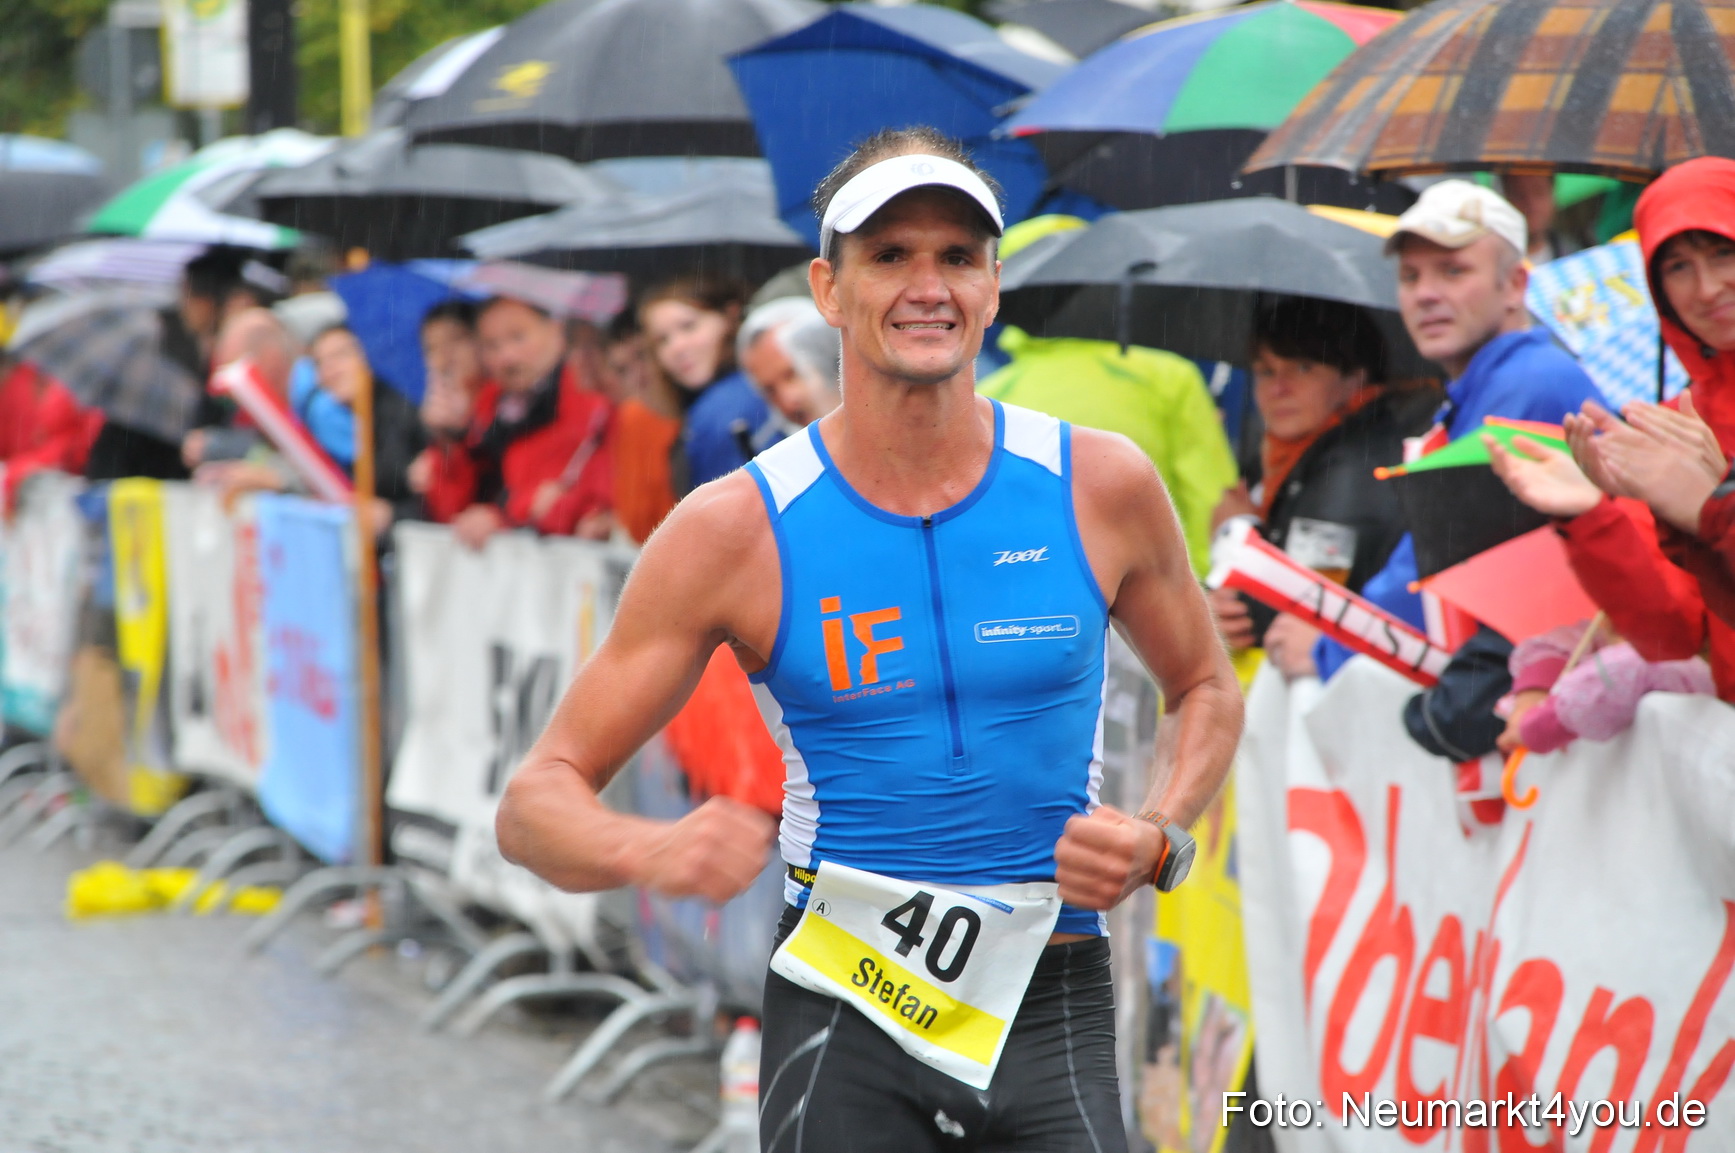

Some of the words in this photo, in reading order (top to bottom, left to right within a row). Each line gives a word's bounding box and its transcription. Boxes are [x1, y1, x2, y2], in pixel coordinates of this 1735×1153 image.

[896, 678, 916, 690] AG
[816, 901, 825, 914] A
[881, 890, 982, 983] 40
[851, 957, 938, 1030] Stefan
